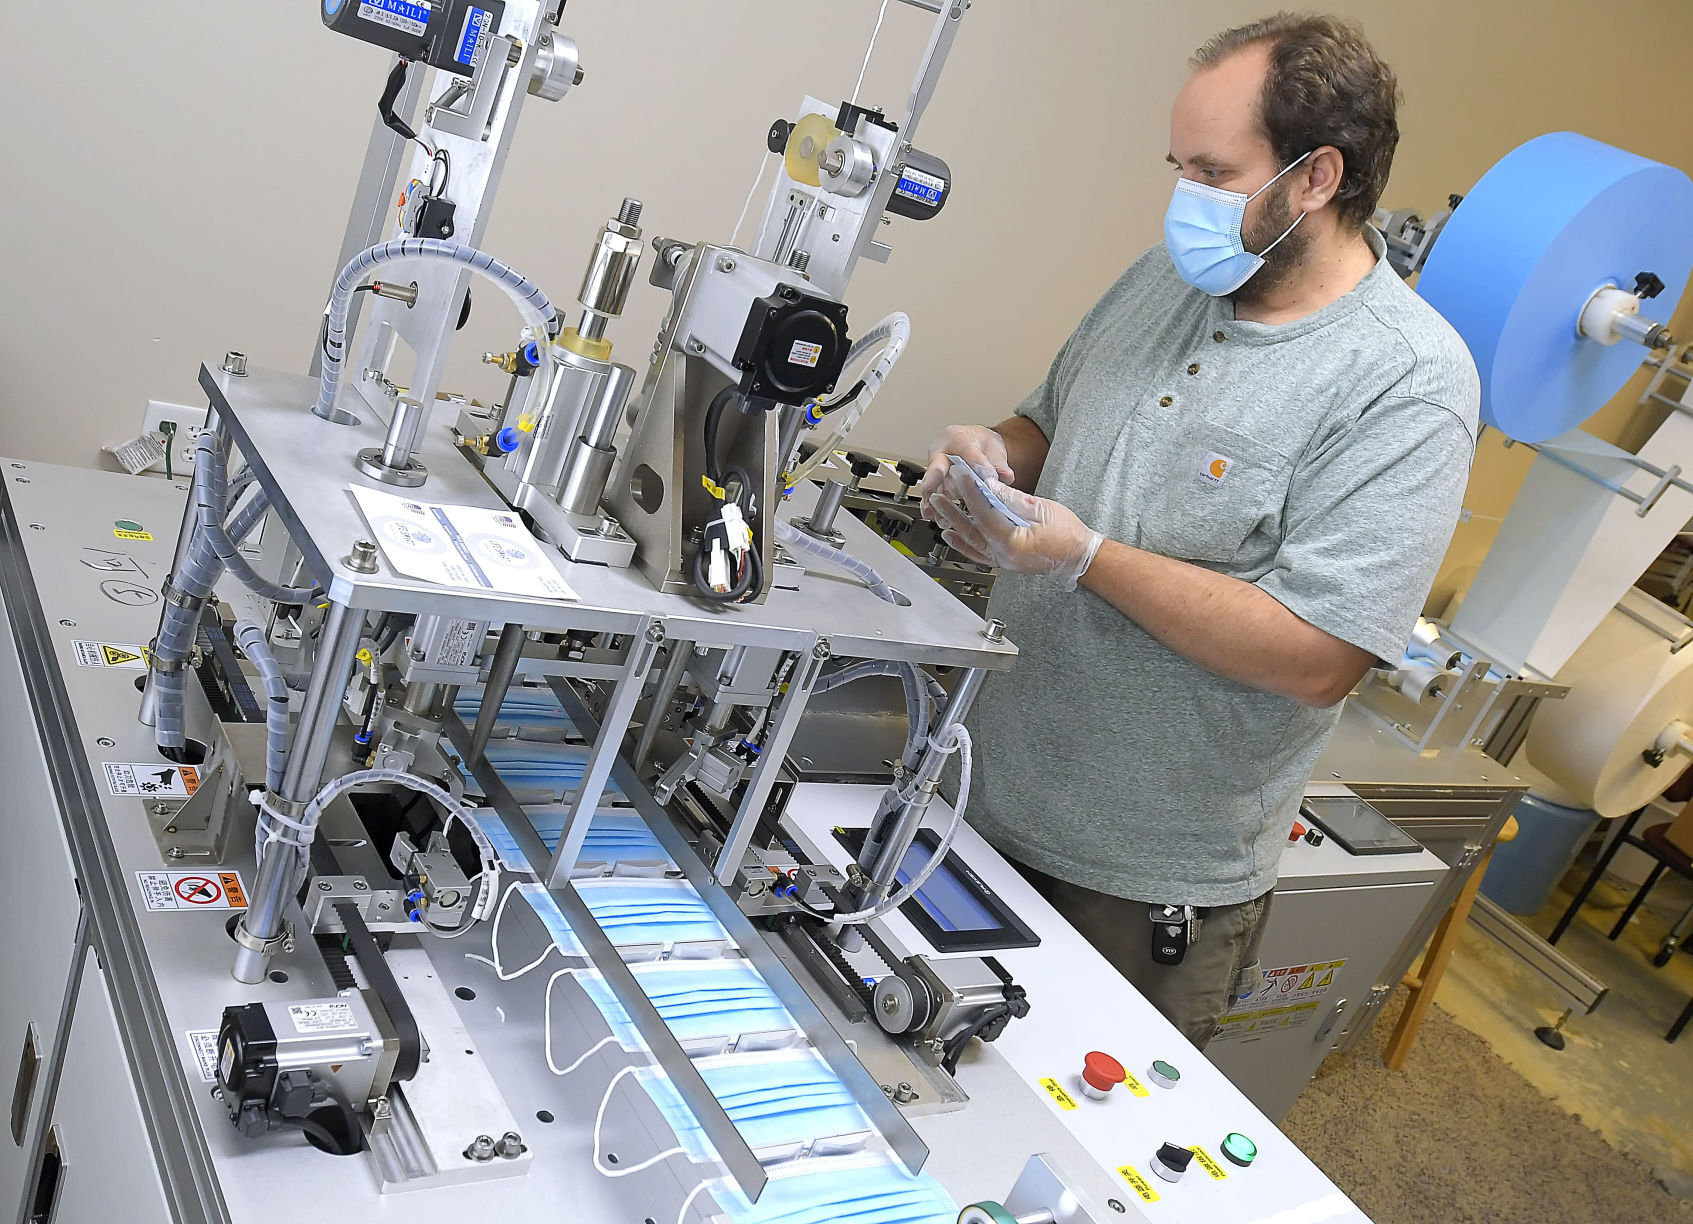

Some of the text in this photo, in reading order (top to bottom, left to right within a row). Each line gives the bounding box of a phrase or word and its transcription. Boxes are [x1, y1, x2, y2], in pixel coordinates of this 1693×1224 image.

[387, 0, 422, 19] MAILI
[464, 29, 477, 57] MAILI
[903, 181, 926, 195] MAILI
